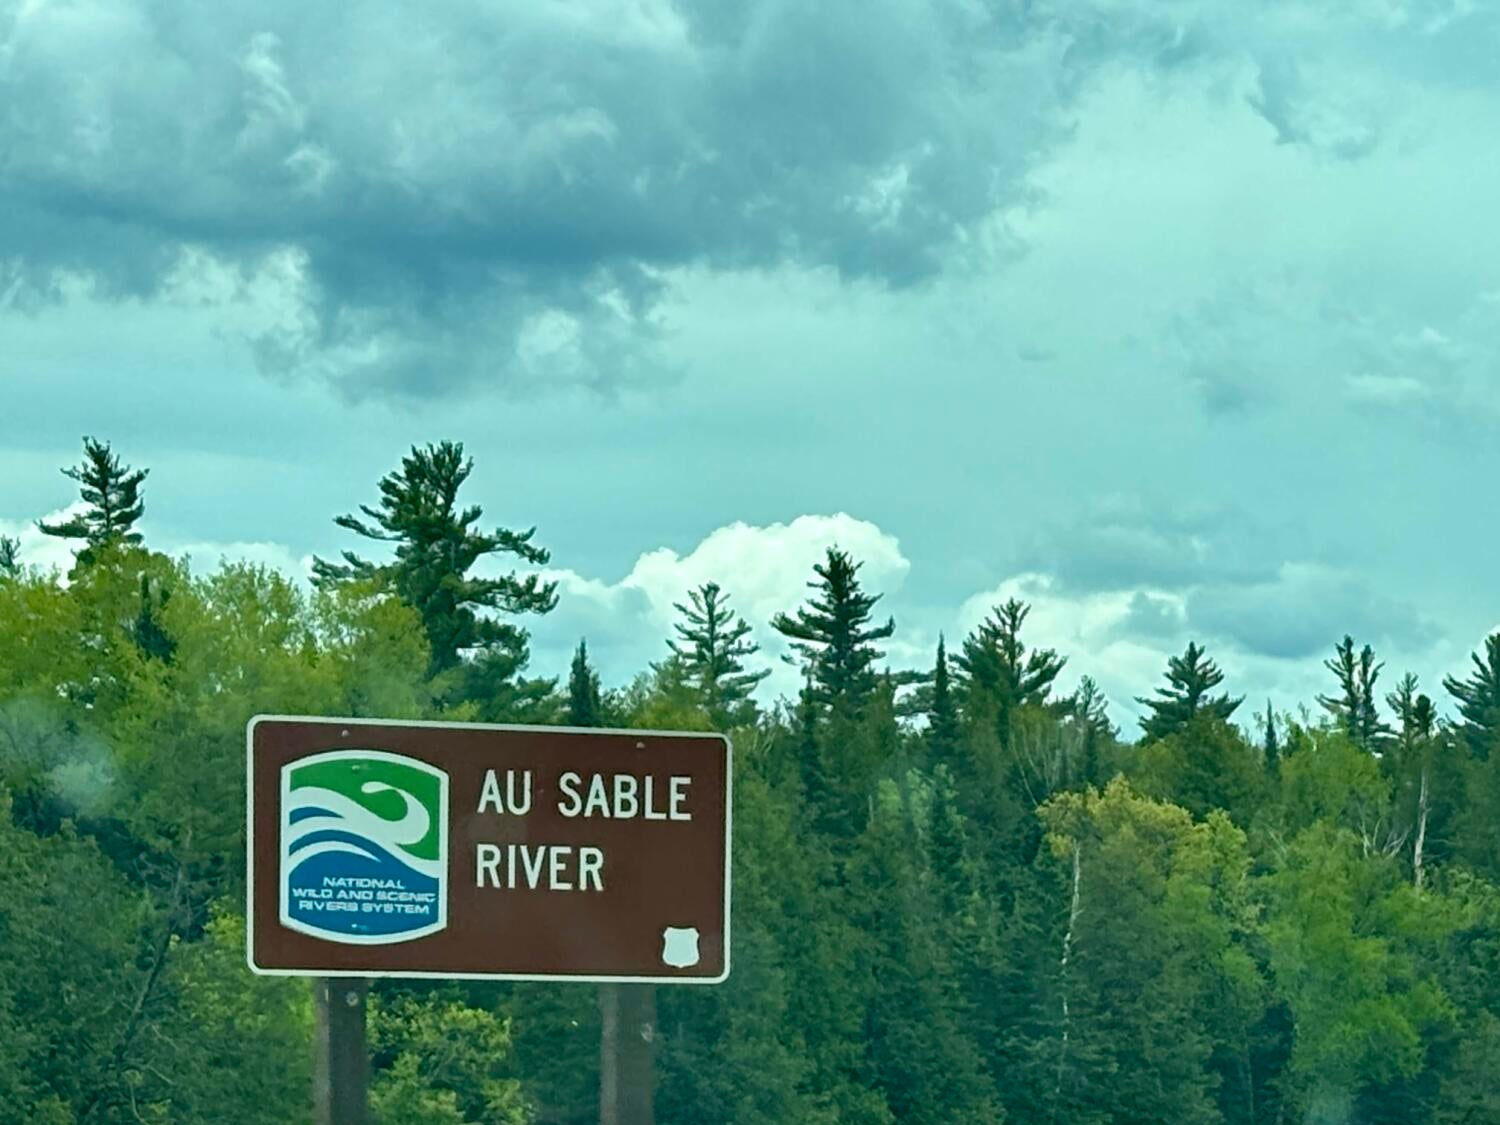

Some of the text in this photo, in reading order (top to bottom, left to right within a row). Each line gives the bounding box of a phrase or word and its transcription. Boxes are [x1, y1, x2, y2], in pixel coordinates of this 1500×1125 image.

[477, 769, 692, 821] AU SABLE
[476, 843, 605, 891] RIVER
[323, 876, 406, 890] NATIONAL
[292, 887, 436, 903] WILD AND SCENIC
[299, 900, 430, 915] RIVERS SYSTEM
